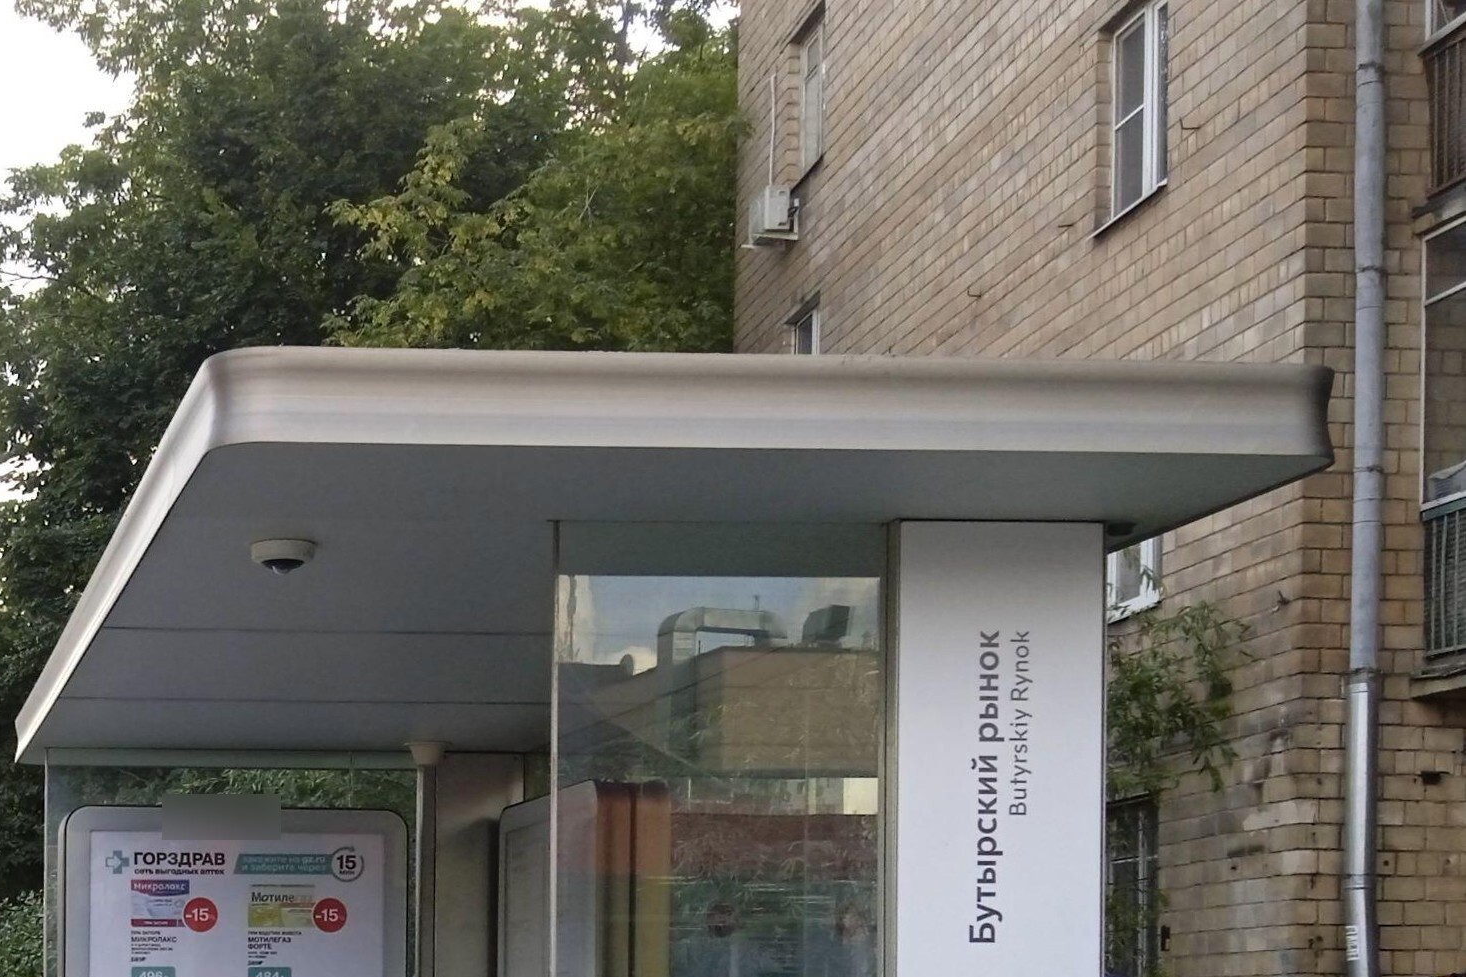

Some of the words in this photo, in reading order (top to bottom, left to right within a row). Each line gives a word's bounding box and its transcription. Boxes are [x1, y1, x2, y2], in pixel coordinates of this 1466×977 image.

[979, 630, 1005, 742] рынок
[1010, 630, 1033, 702] Rynok
[1009, 708, 1032, 816] Butyrskiy
[134, 852, 225, 867] ГОРЗДРАВ
[337, 855, 356, 870] 15
[969, 756, 1003, 944] Бутырский
